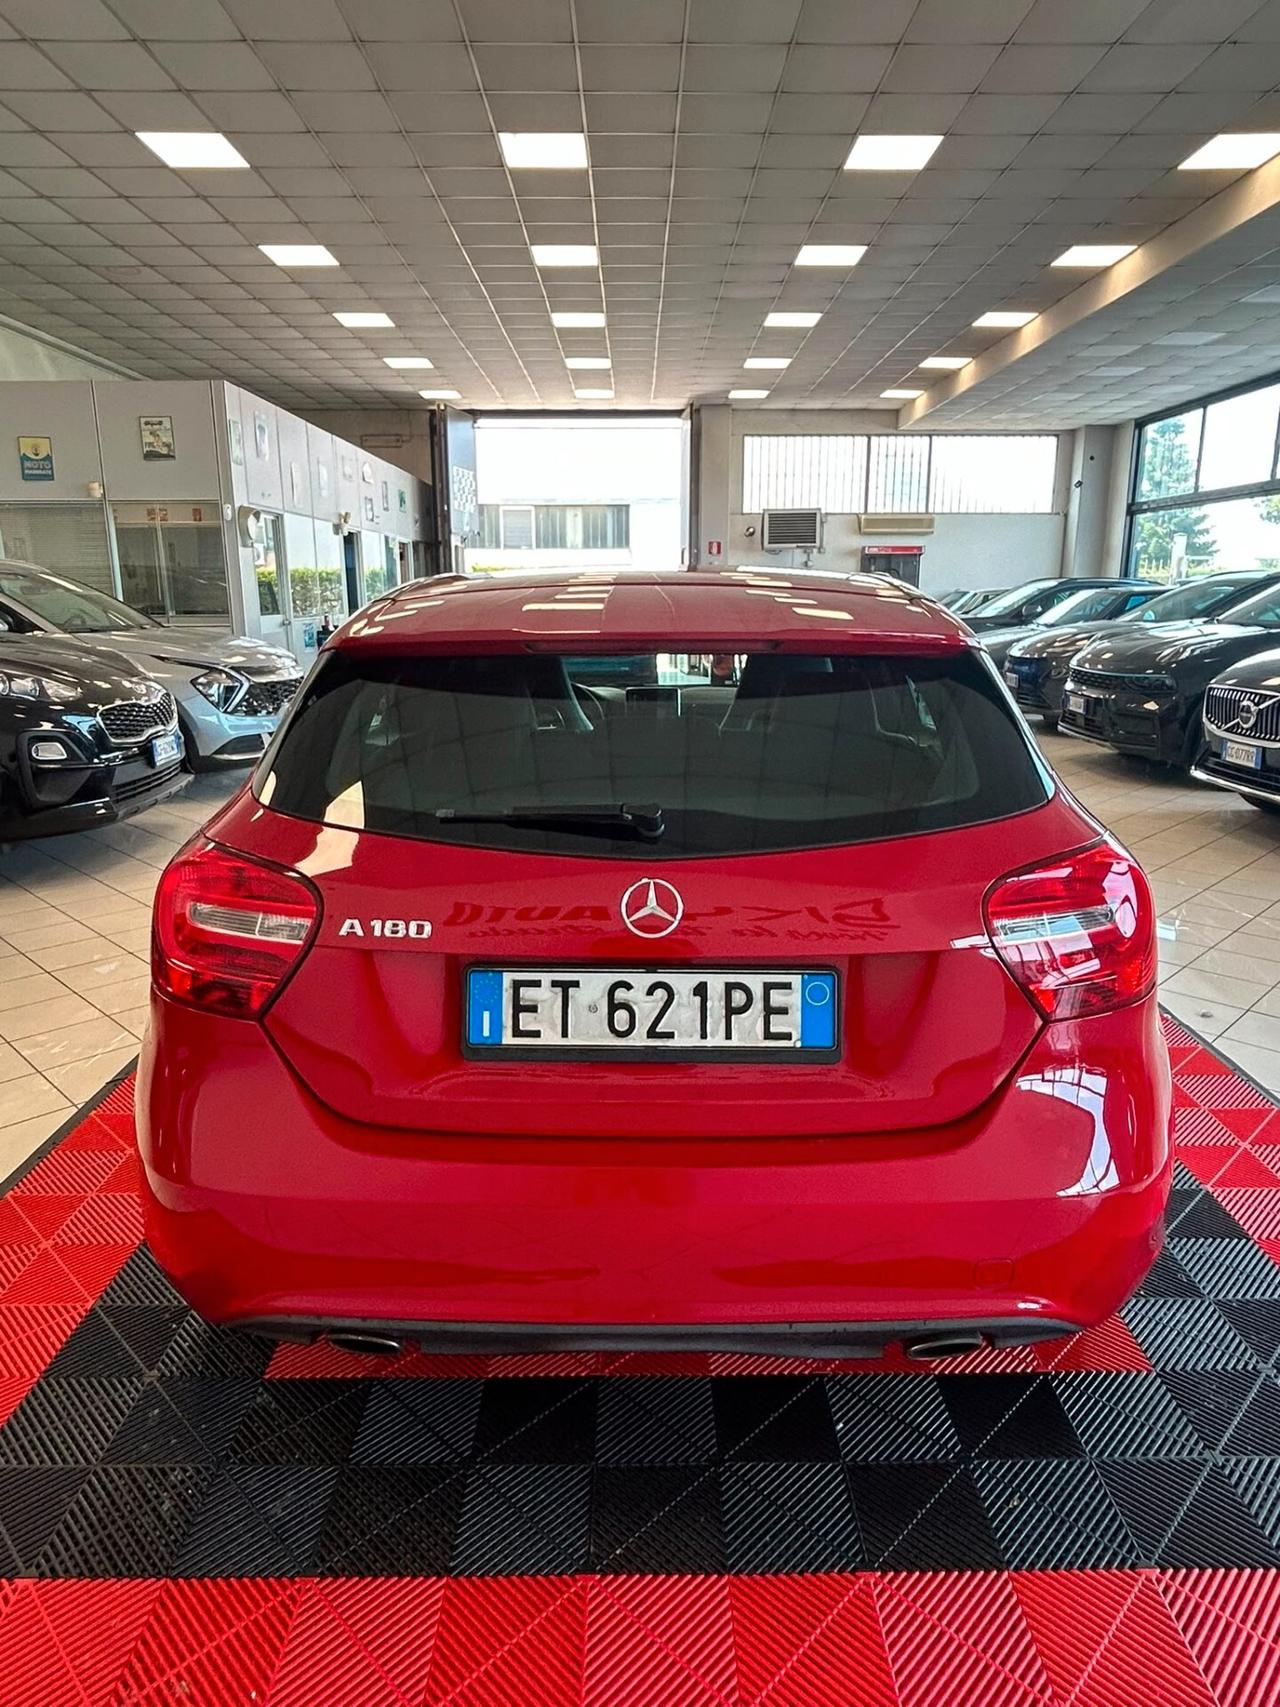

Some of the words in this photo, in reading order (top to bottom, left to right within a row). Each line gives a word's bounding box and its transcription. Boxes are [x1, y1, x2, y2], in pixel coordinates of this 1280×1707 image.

[339, 919, 364, 937] A
[370, 919, 432, 938] 180
[511, 979, 580, 1039] ET
[607, 981, 793, 1042] 621PE
